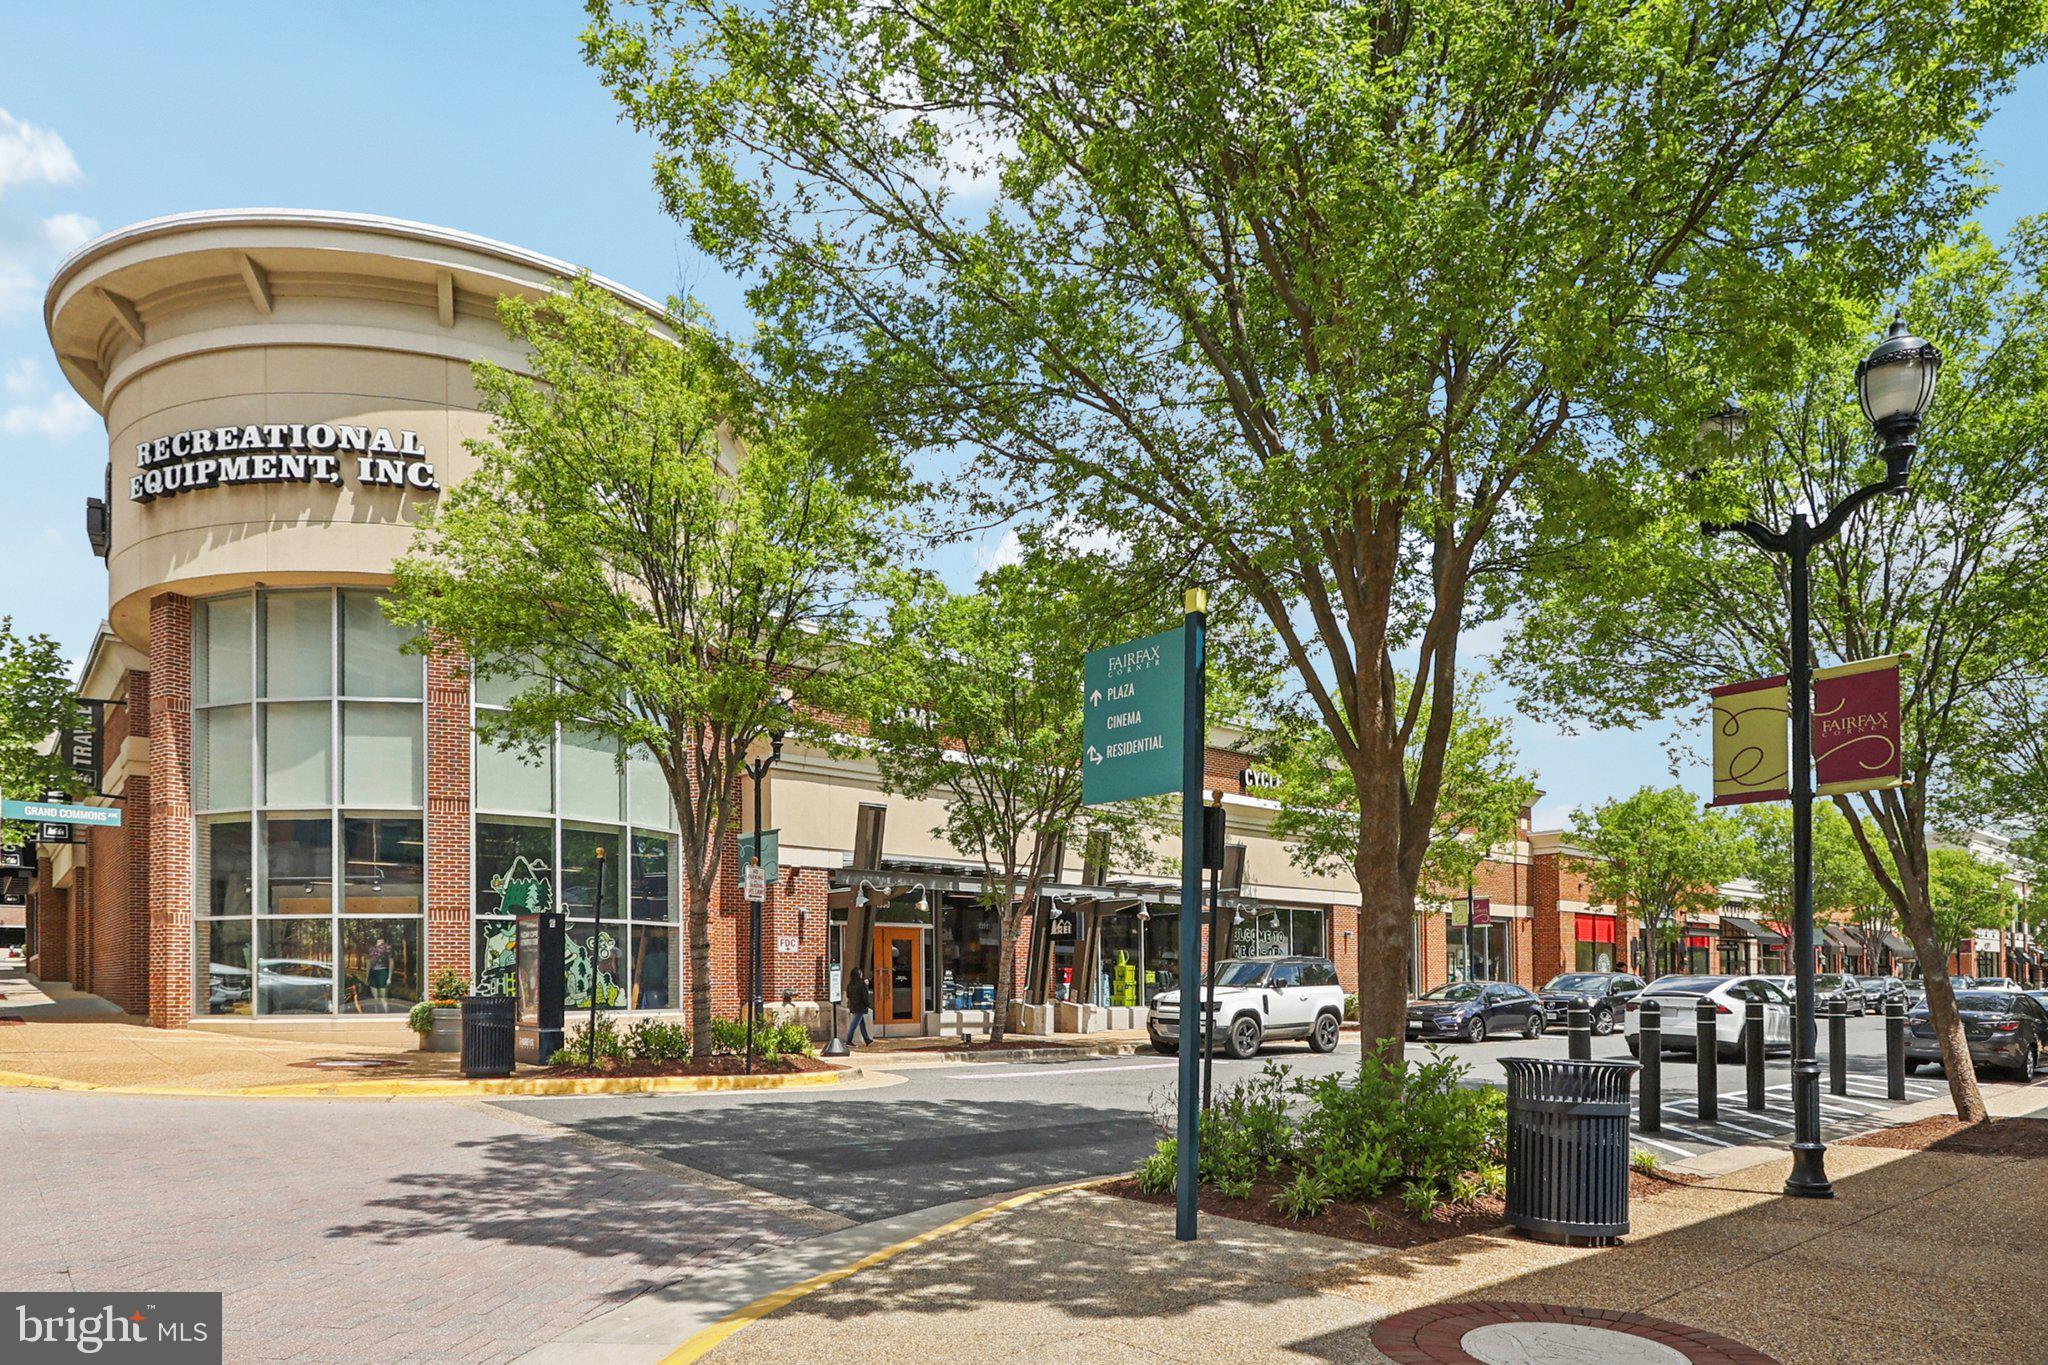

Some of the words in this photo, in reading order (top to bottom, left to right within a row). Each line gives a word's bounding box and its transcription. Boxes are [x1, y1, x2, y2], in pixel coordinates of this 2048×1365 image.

[136, 423, 426, 468] RECREATIONAL
[129, 455, 340, 500] EQUIPMENT,
[357, 457, 440, 490] INC.
[1108, 645, 1160, 671] FAIRFAX
[1107, 660, 1160, 678] CORNER
[1107, 682, 1135, 701] PLAZA
[1107, 710, 1142, 730] CINEMA
[1822, 711, 1888, 733] FAIRFAX
[1821, 723, 1889, 738] CORNER
[1106, 735, 1164, 759] RESIDENTIAL
[24, 806, 57, 817] GRAND
[59, 808, 107, 821] COMMONS
[780, 938, 796, 948] FDC
